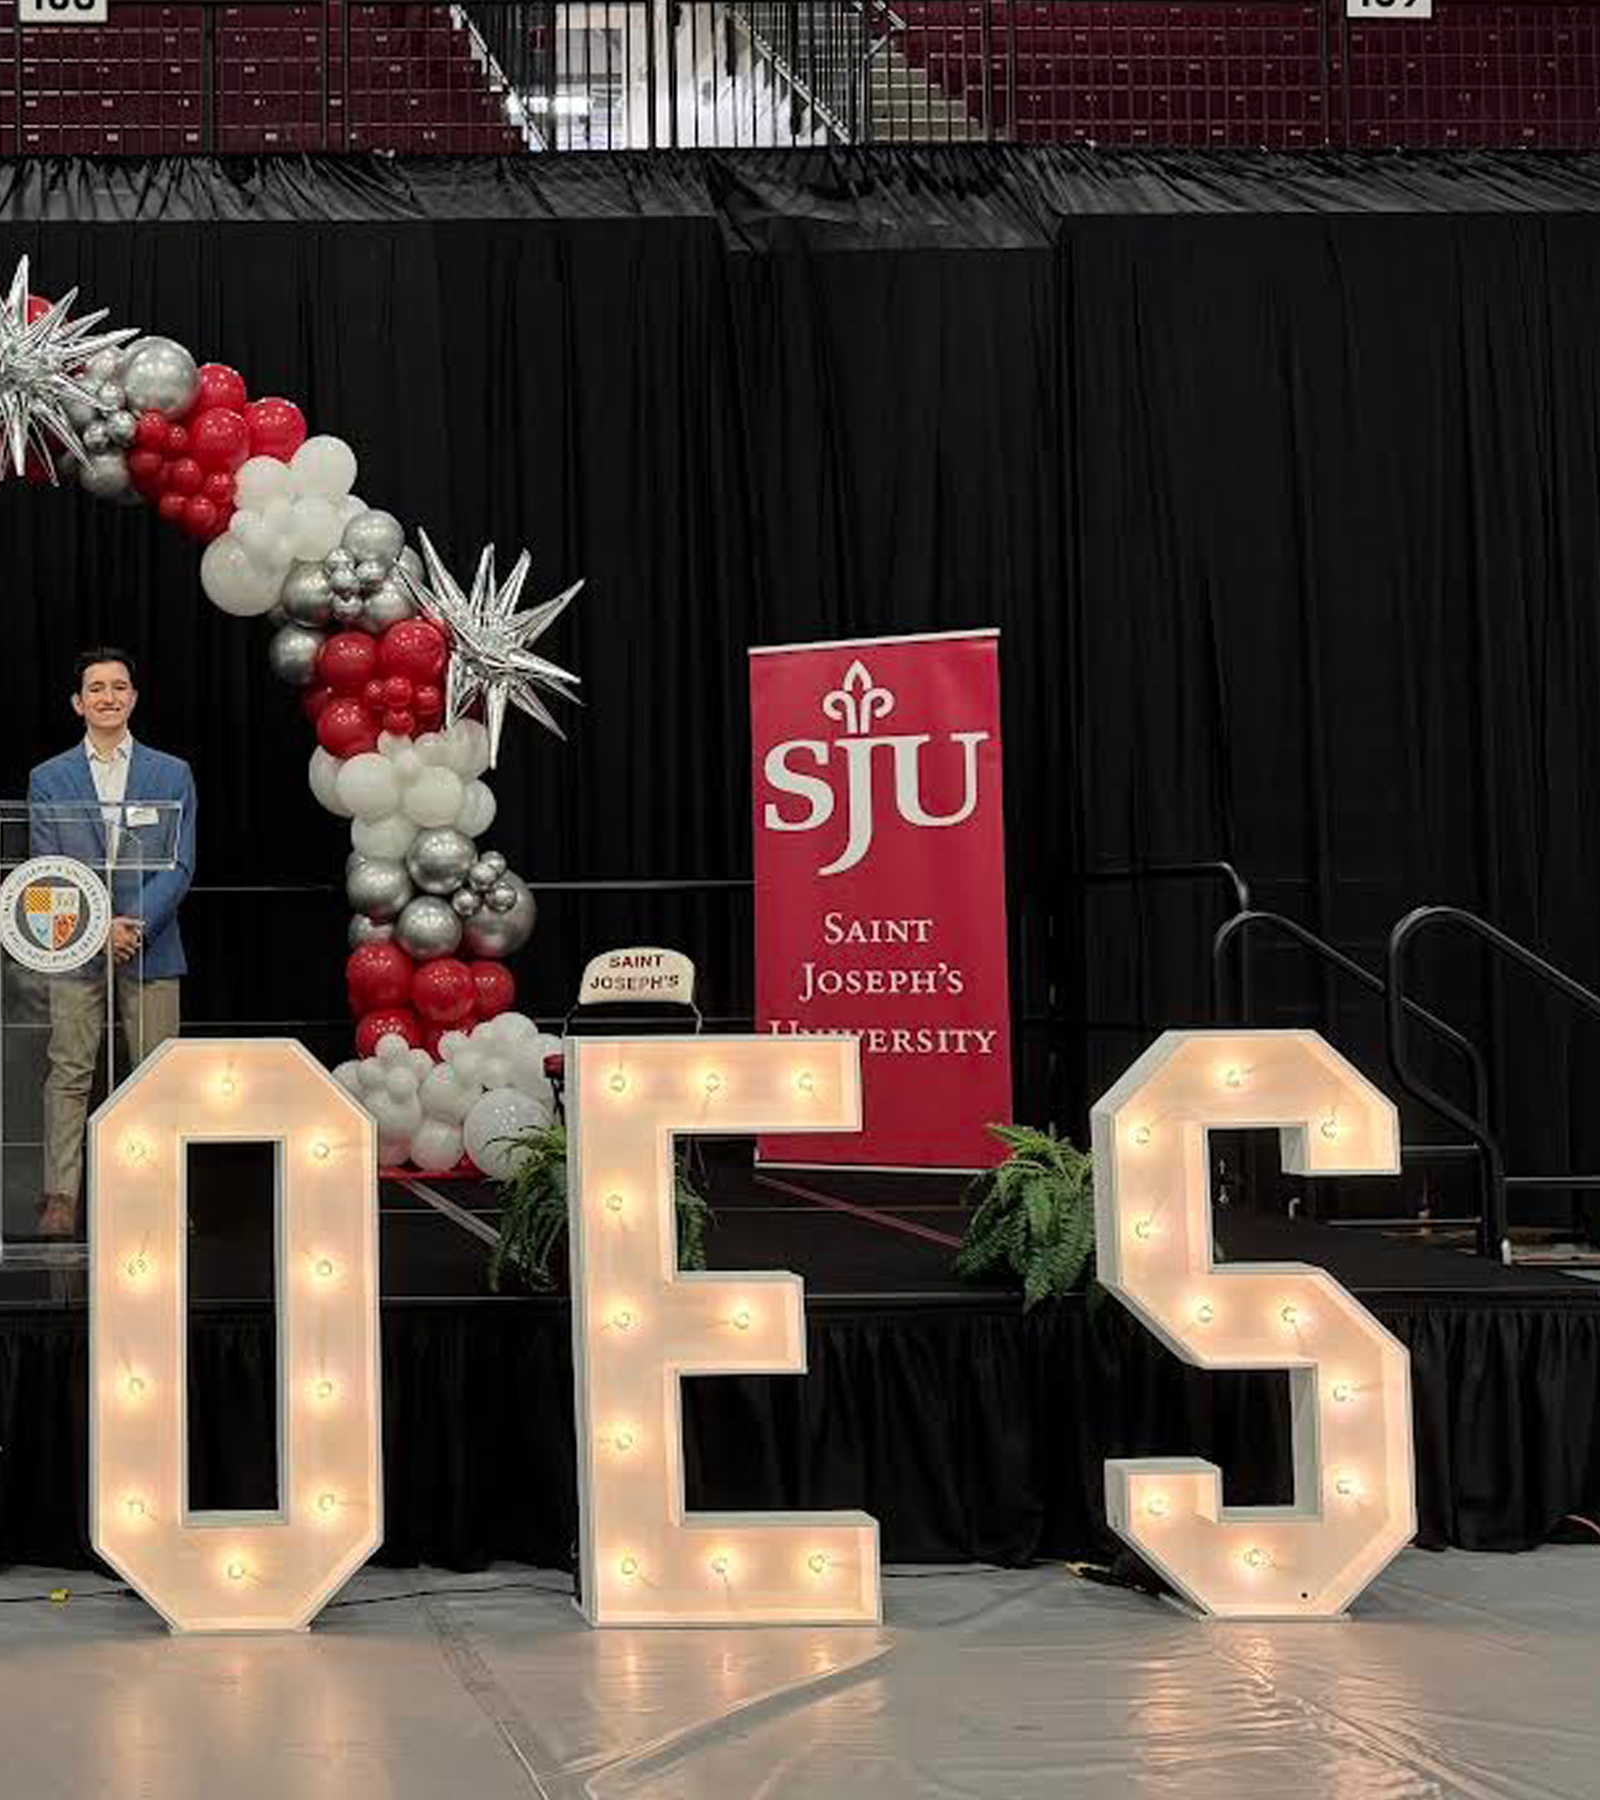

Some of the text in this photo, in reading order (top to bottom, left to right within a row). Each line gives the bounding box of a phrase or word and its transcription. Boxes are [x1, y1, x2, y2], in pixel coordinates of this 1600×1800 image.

[764, 731, 990, 876] SJU
[824, 912, 933, 944] SAINT
[608, 953, 665, 969] SAINT
[589, 973, 680, 992] JOSEPH'S
[798, 962, 964, 1003] JOSEPH'S
